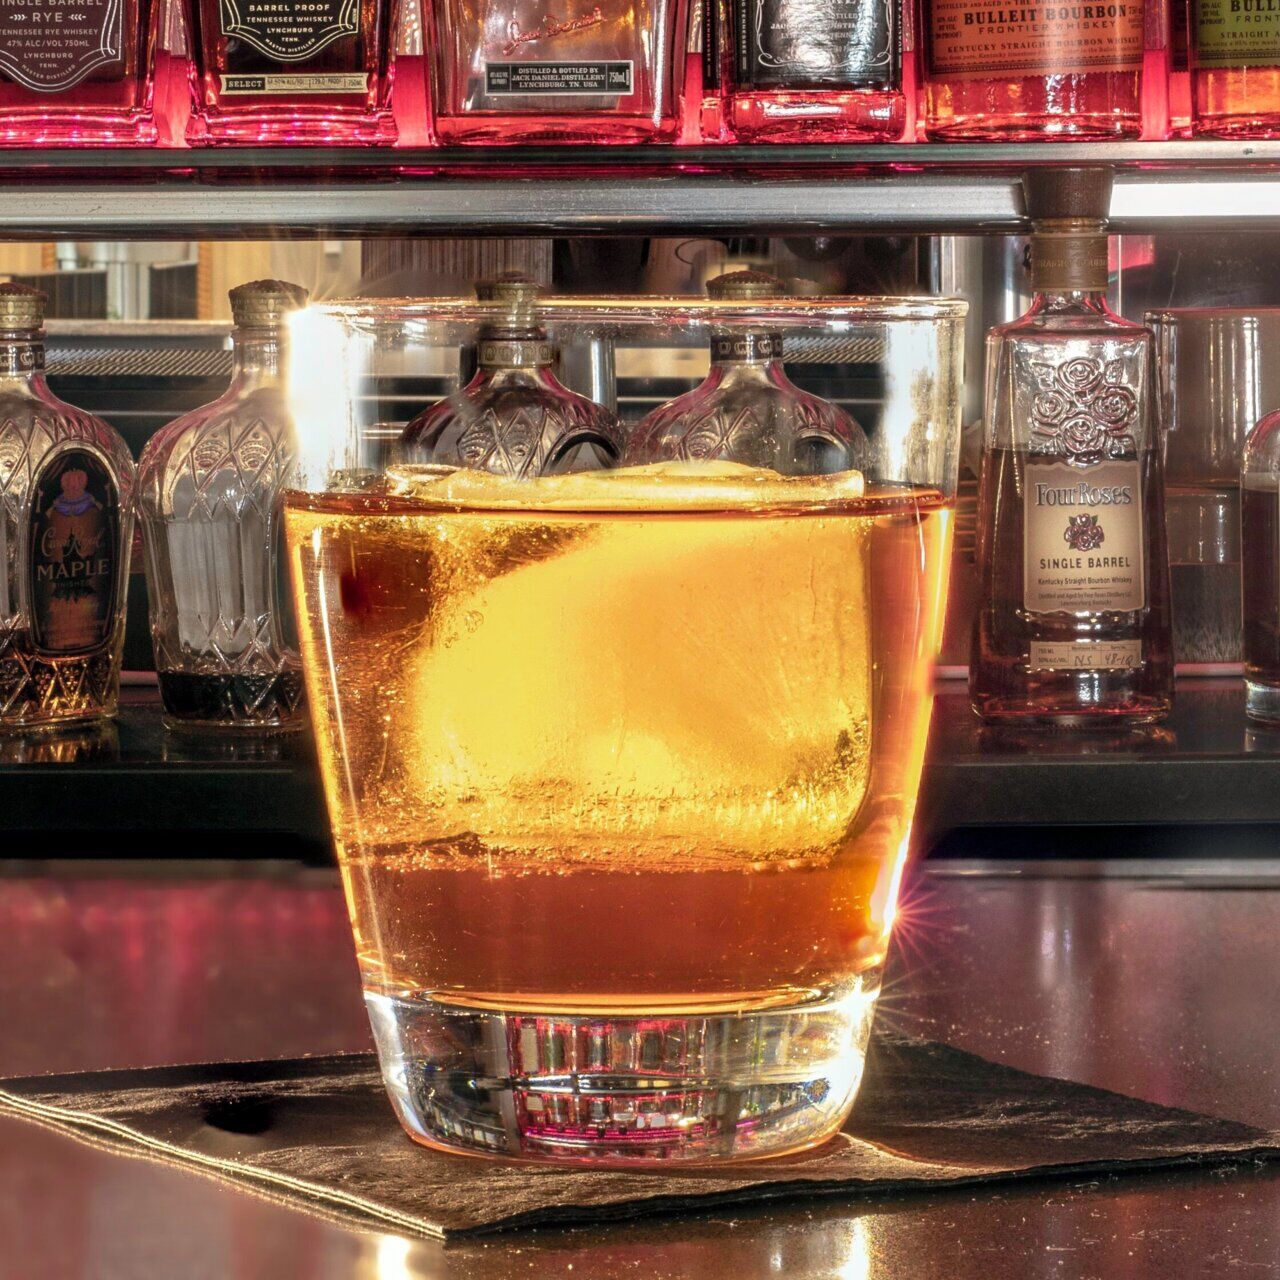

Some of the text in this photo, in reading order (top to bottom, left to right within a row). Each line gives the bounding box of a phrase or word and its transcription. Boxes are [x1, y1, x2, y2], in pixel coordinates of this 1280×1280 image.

[32, 12, 63, 23] RYE
[963, 8, 1037, 27] BULLEIT
[1045, 4, 1127, 22] BOURBON
[229, 80, 262, 88] SELECT
[1035, 481, 1133, 507] Four Roses
[35, 559, 110, 582] MAPLE
[1040, 557, 1130, 569] SINGLE BARREL
